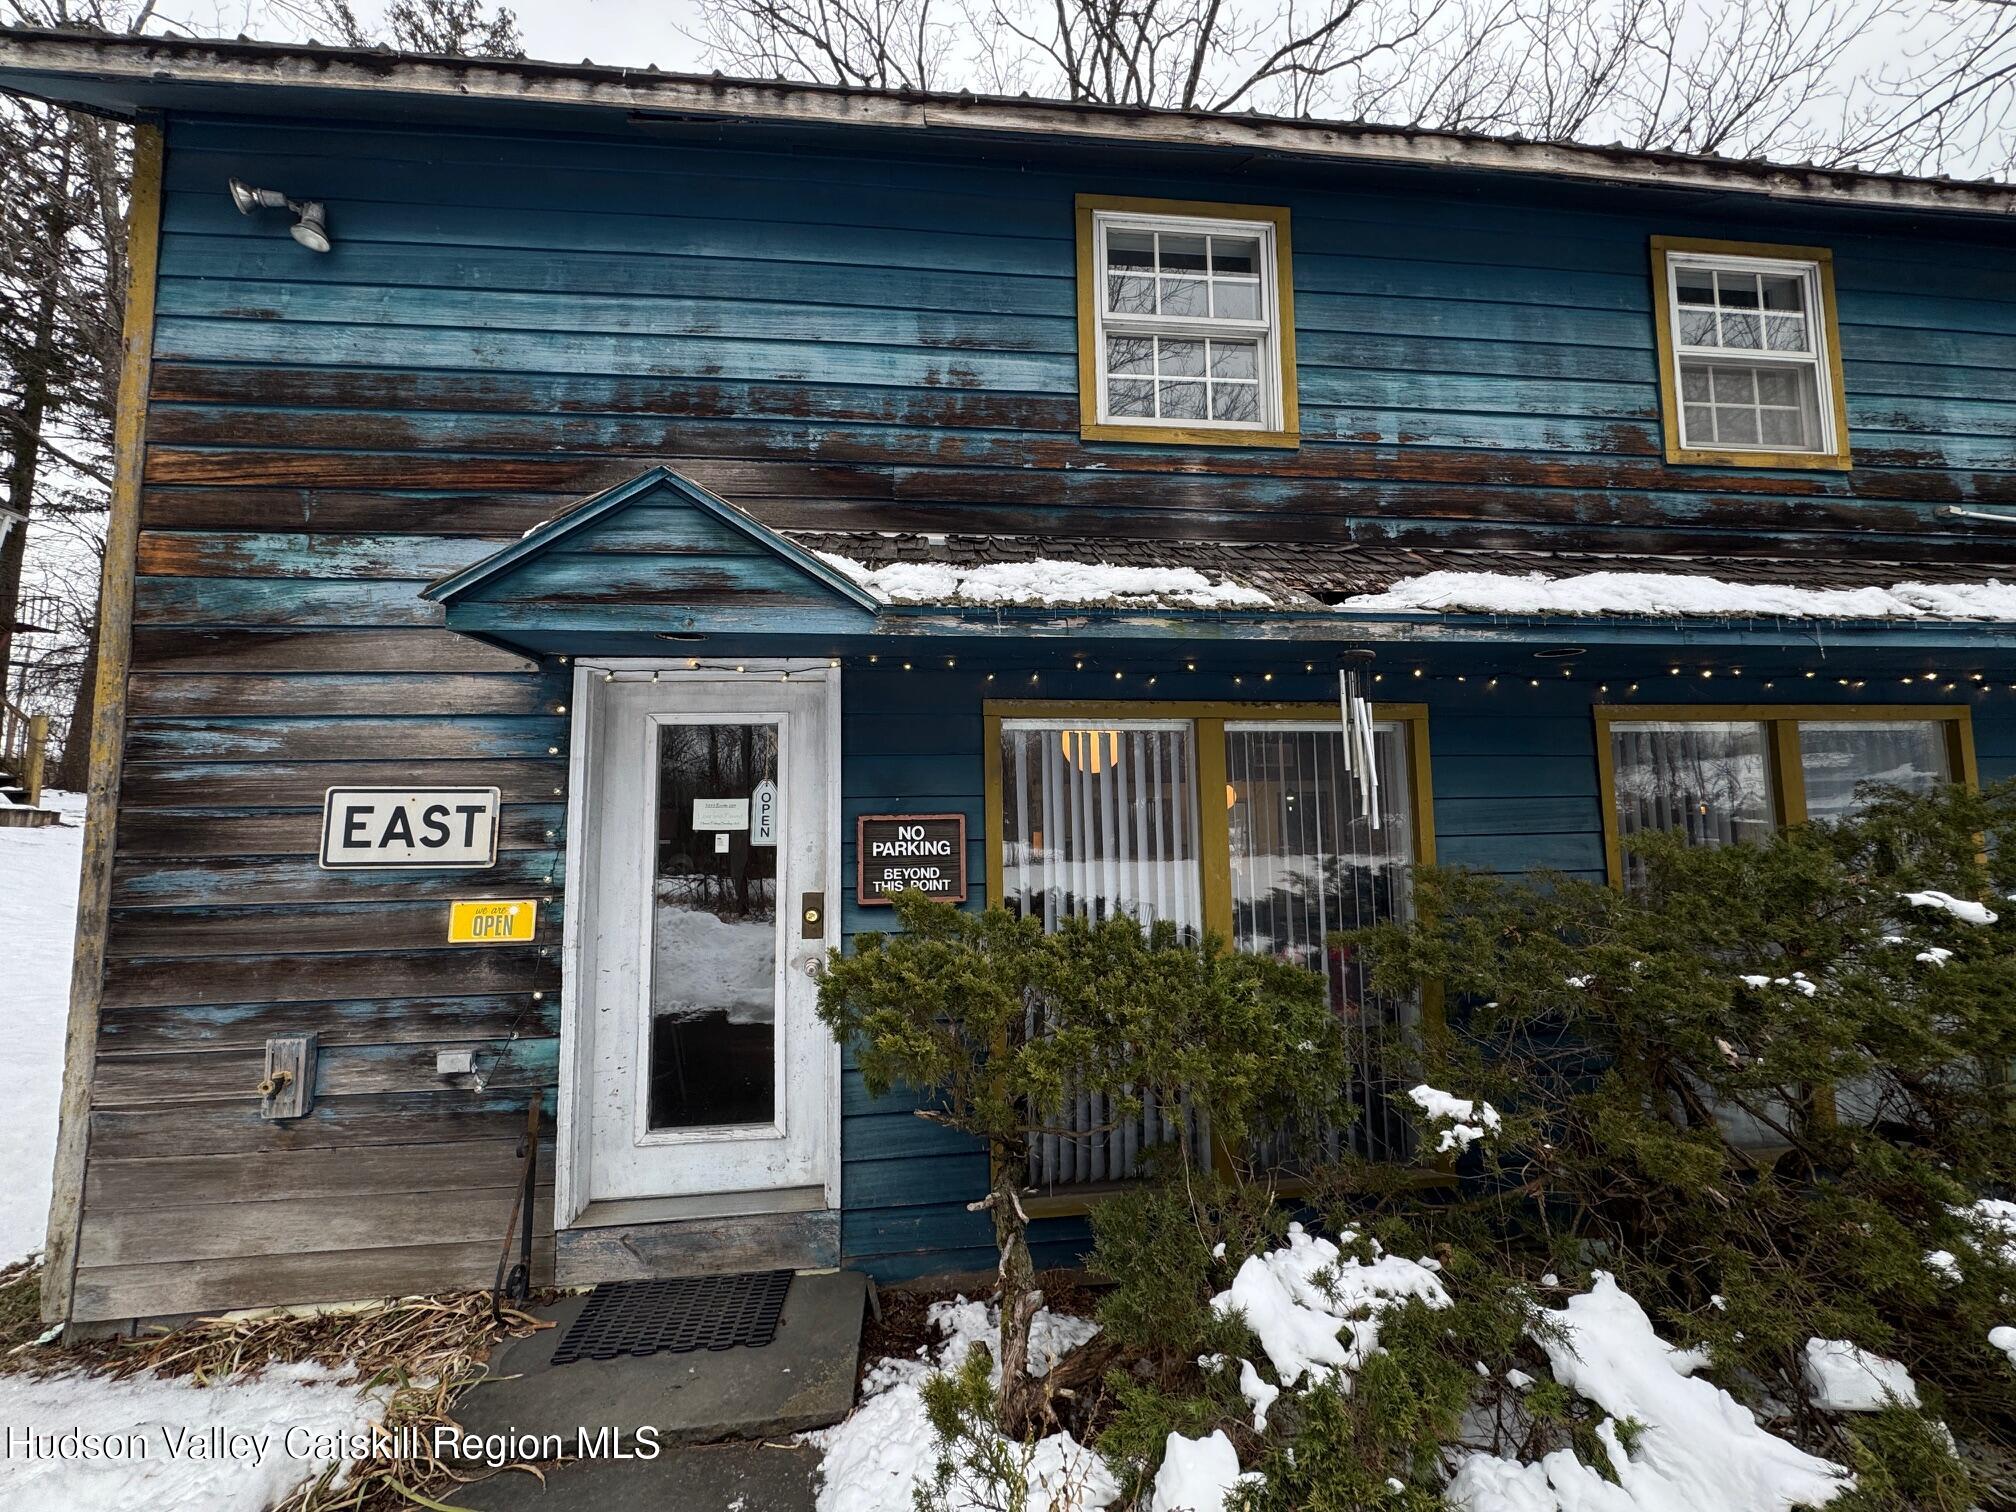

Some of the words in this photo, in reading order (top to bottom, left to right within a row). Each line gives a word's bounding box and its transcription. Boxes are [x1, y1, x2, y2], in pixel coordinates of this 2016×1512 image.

[761, 792, 772, 838] OPEN
[342, 804, 486, 849] EAST
[898, 825, 925, 841] NO
[872, 840, 951, 857] PARKING
[883, 867, 940, 880] BEYOND
[872, 880, 904, 893] THIS
[910, 879, 951, 892] POINT
[475, 907, 488, 915] we
[491, 907, 506, 915] are
[473, 914, 514, 937] OPEN
